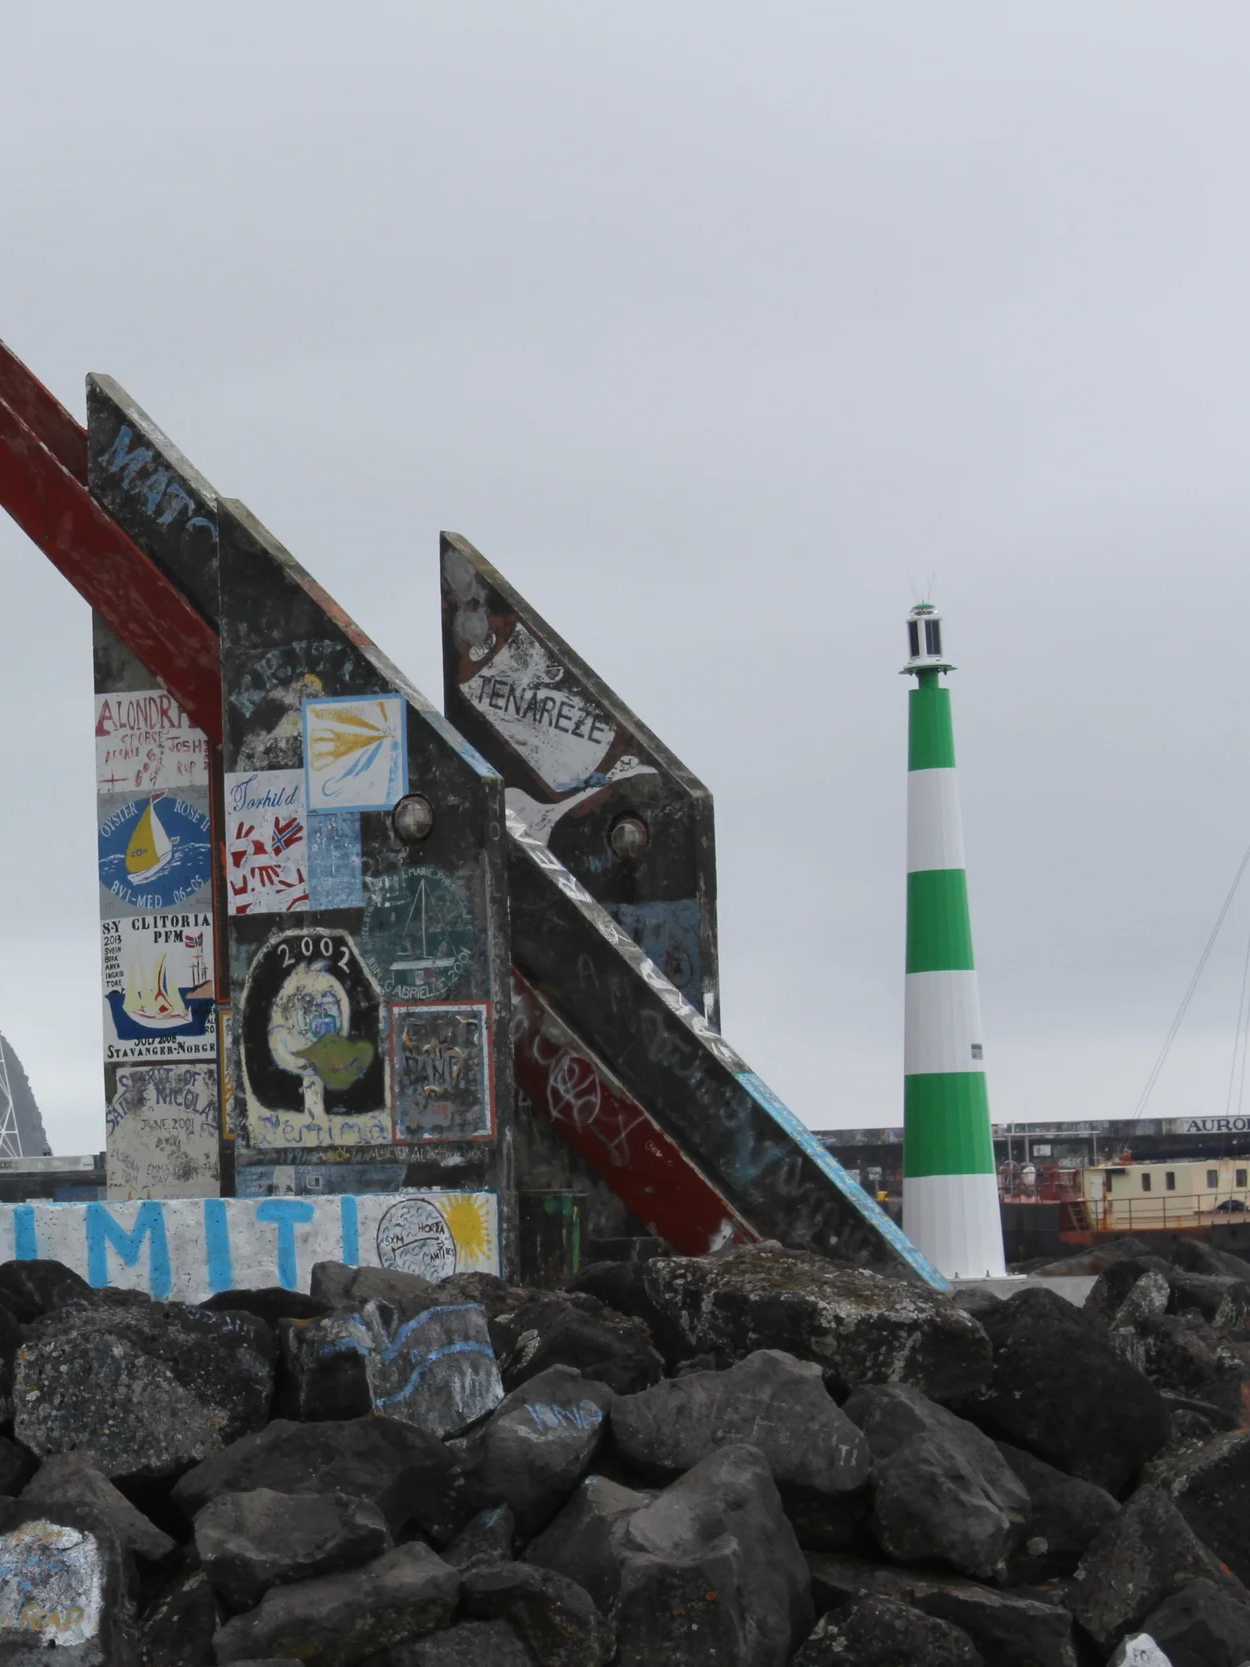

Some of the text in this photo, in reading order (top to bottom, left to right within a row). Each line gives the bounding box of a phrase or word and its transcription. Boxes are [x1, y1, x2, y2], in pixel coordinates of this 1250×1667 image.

[101, 802, 138, 837] OYSTER
[174, 799, 201, 823] ROSE
[111, 880, 162, 908] BVI-MED
[132, 914, 210, 930] CLITORIA
[104, 936, 122, 946] 2013
[154, 930, 183, 943] PFM
[278, 937, 351, 974] 2002
[1187, 1118, 1250, 1132] AURO
[418, 1221, 445, 1235] HORTA
[385, 1234, 404, 1246] SXM
